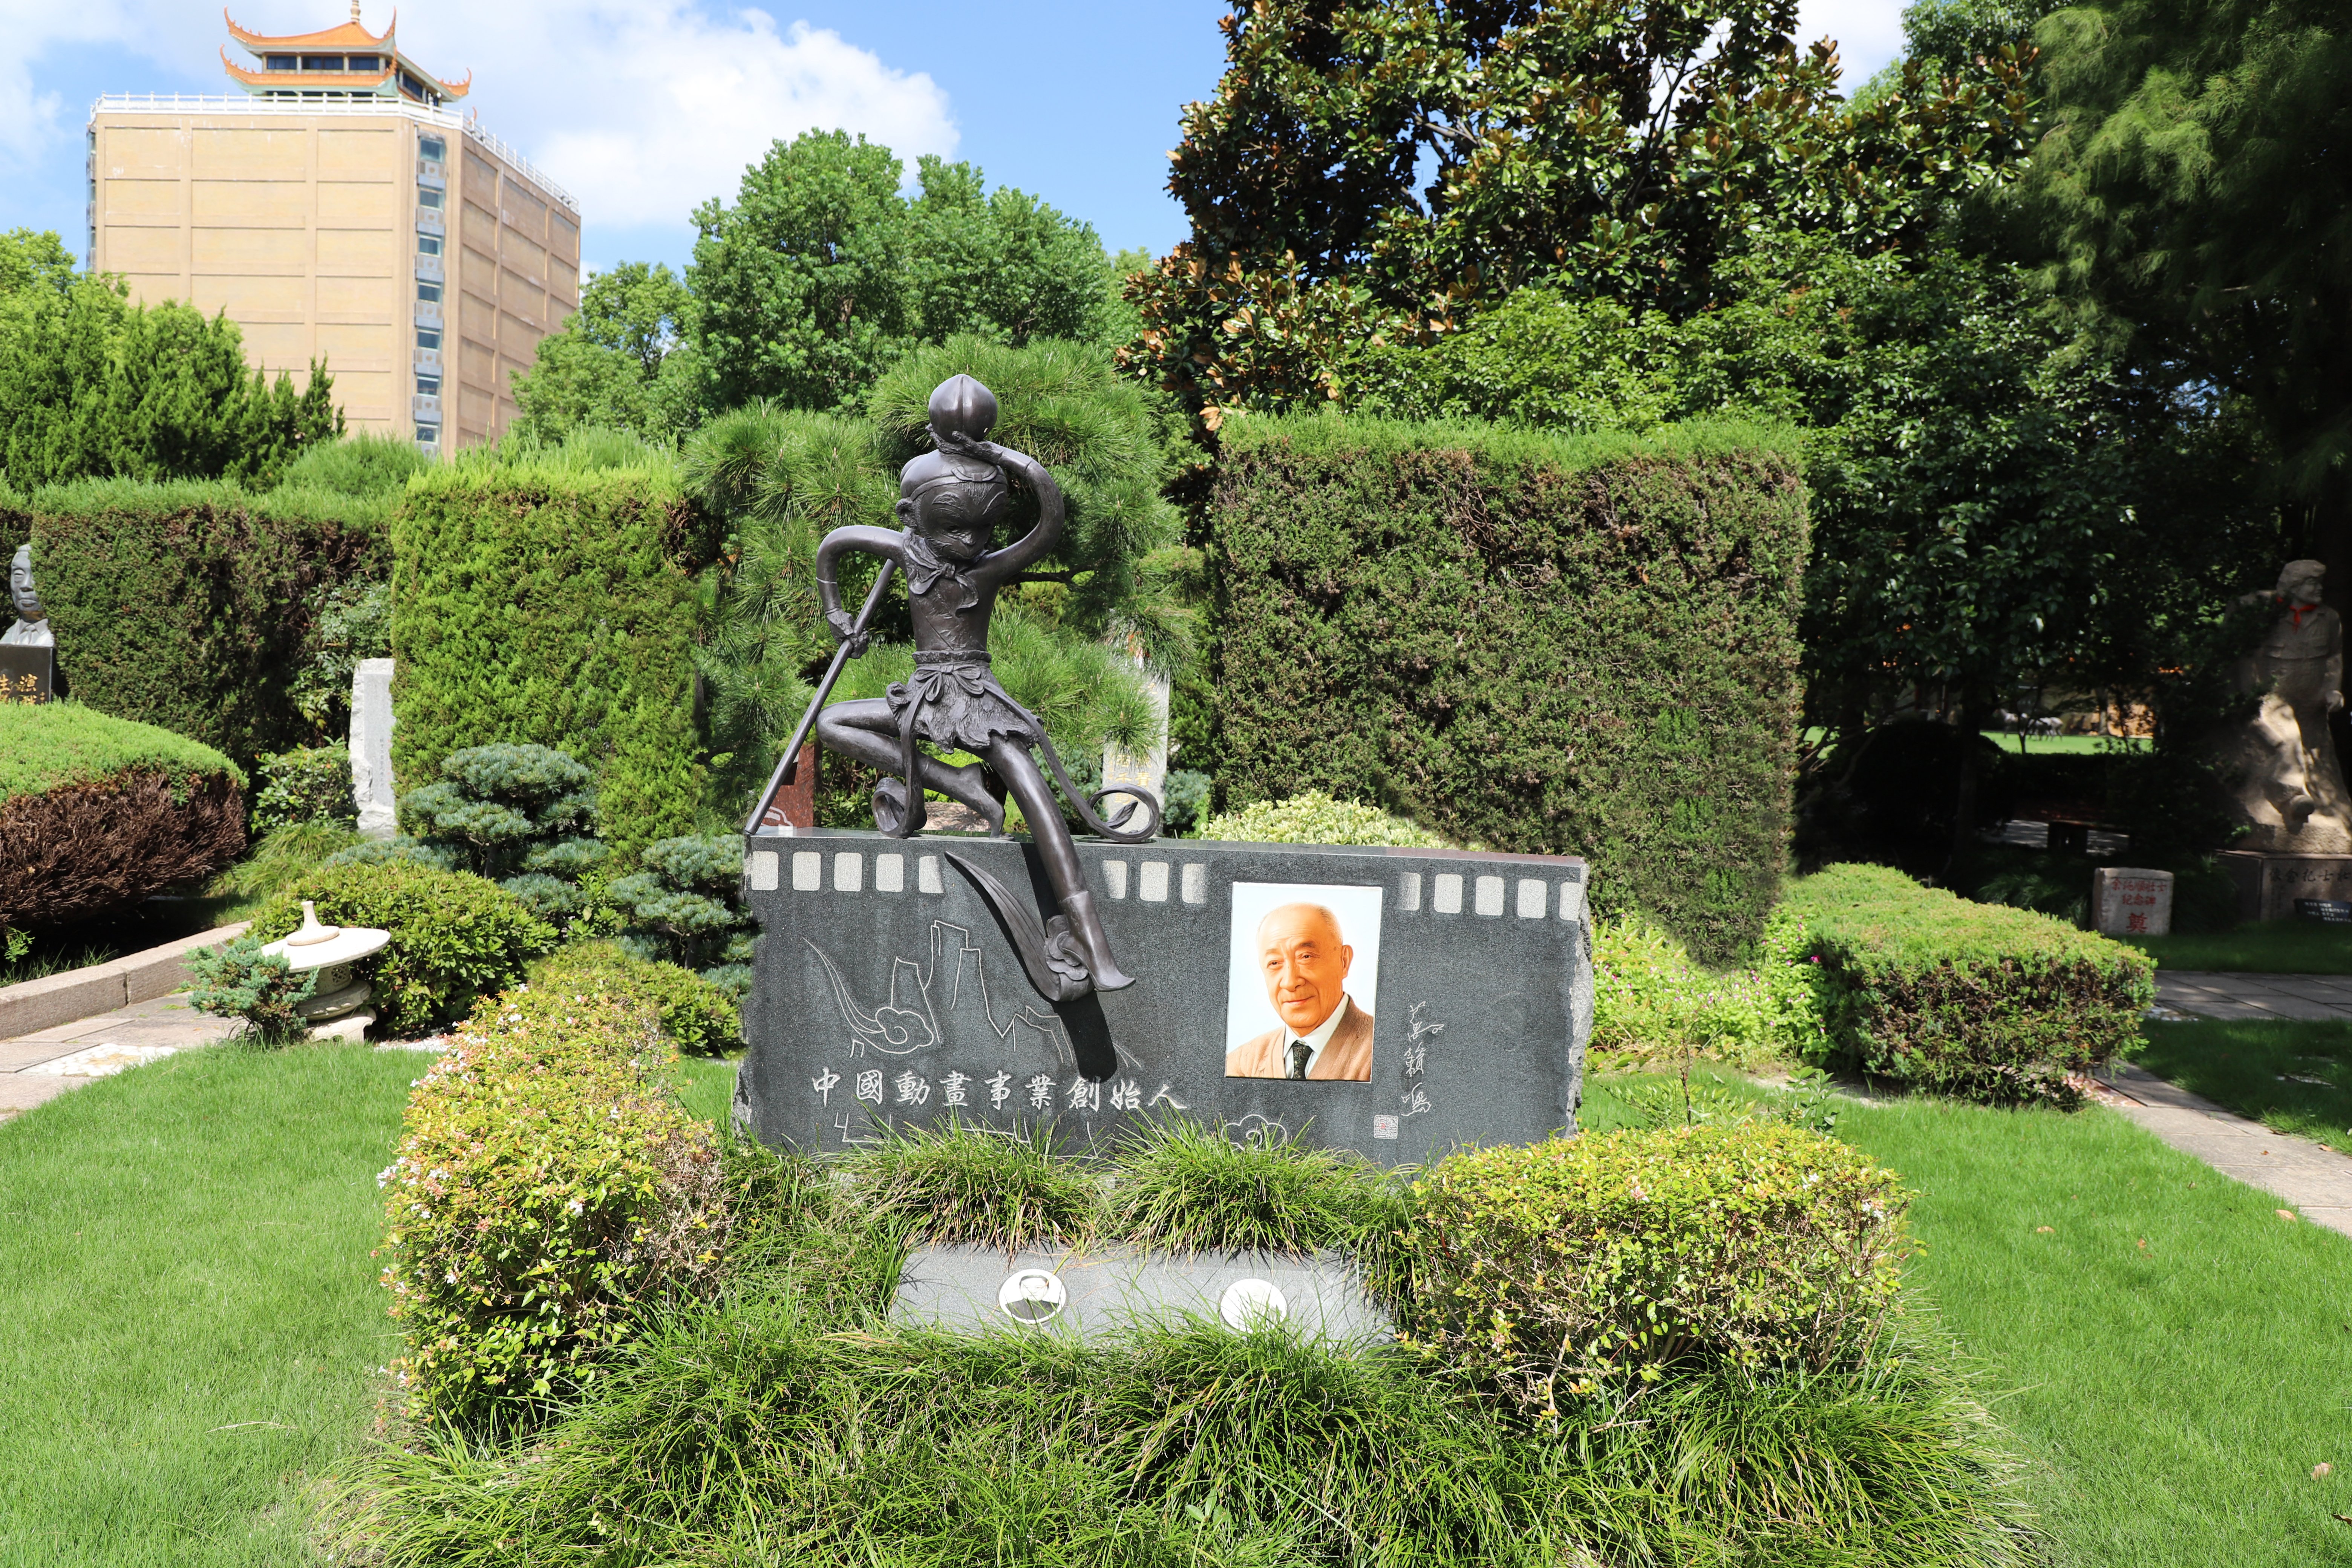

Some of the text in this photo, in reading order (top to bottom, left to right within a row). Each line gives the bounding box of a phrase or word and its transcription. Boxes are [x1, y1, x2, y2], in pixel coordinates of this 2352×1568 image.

[812, 1066, 1187, 1112] 中國動畫事業創始人
